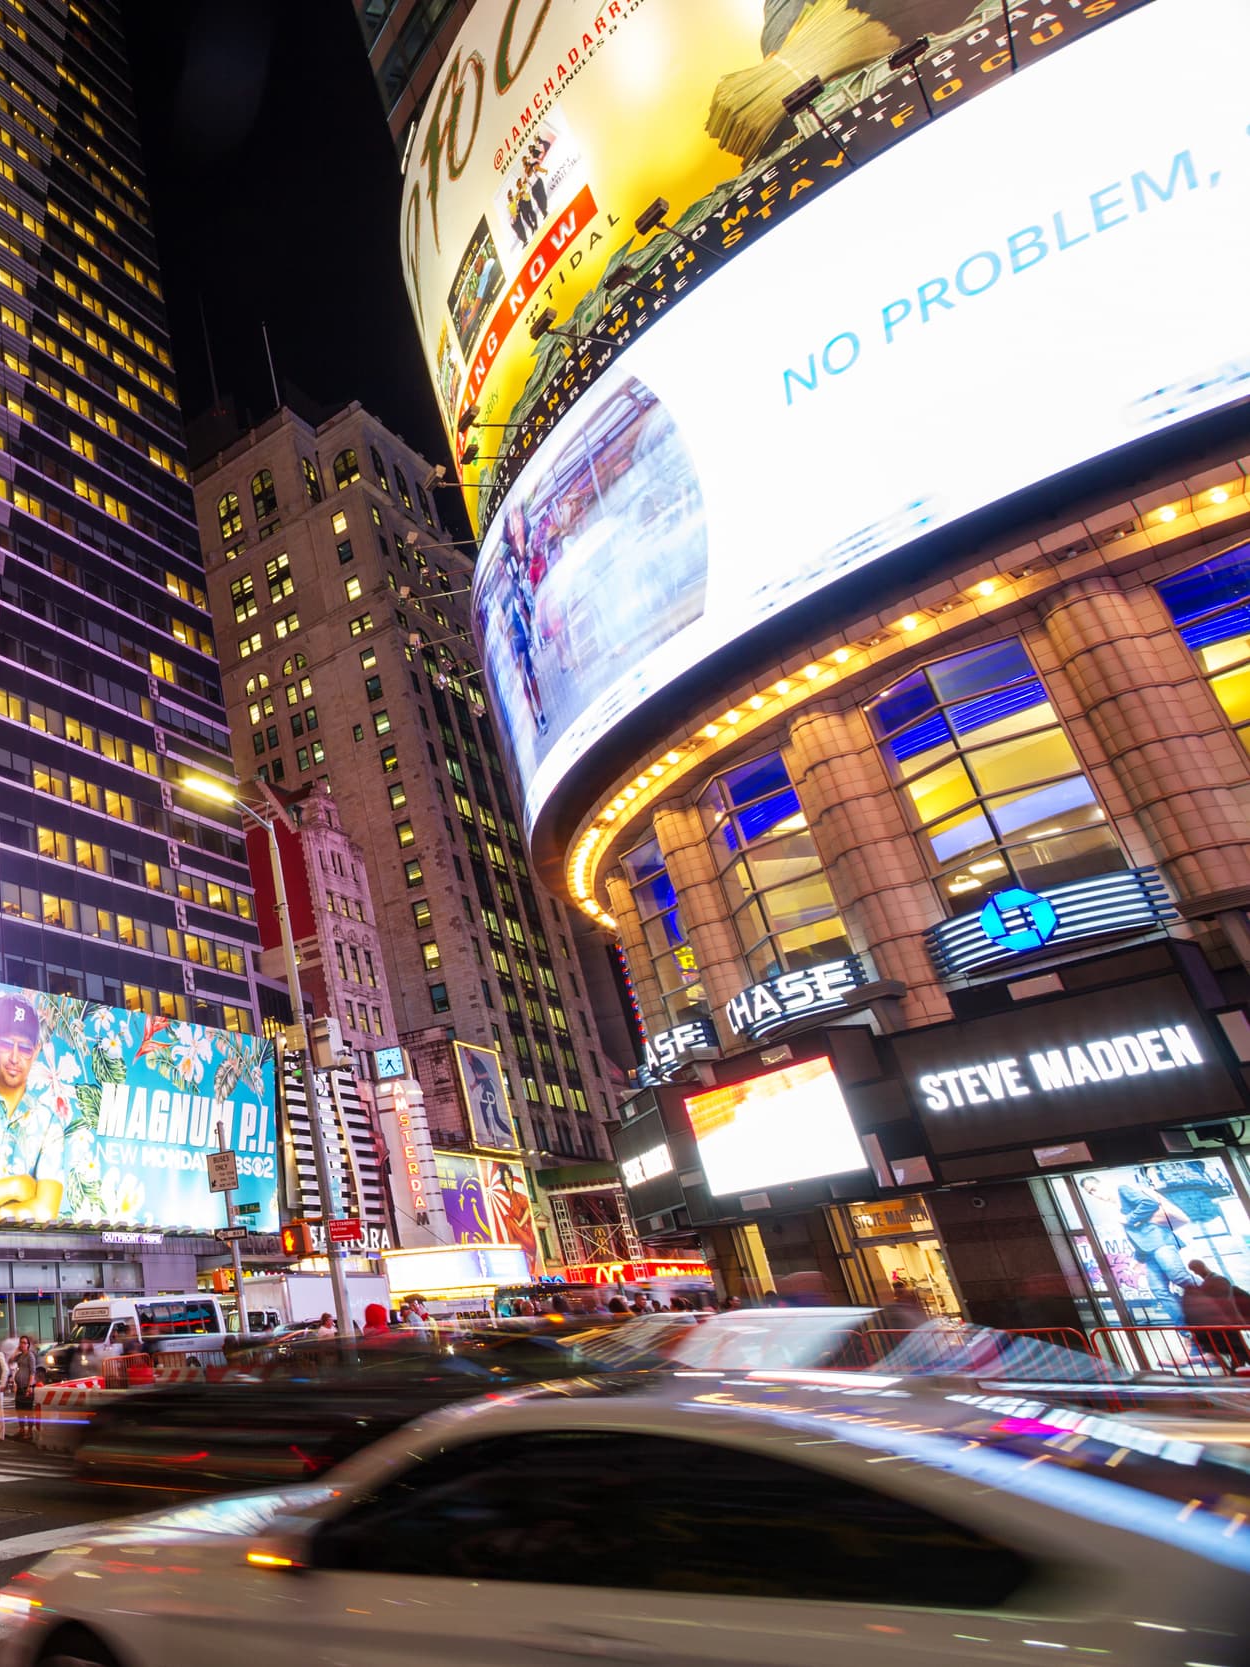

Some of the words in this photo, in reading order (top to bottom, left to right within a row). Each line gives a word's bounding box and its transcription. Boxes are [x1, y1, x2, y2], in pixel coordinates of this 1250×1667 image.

[493, 0, 630, 171] @IAMCHADARR
[500, 100, 552, 175] BILLBOARD
[554, 37, 605, 98] SINGLES
[822, 0, 1050, 139] BILLBOA
[722, 151, 844, 248] STAY
[509, 210, 576, 315] NOW
[544, 213, 620, 300] TIDAL
[608, 250, 695, 336] WITH
[783, 331, 860, 406] NO
[881, 149, 1221, 345] PROBLEM,
[726, 960, 857, 1035] CHASE
[919, 1058, 1031, 1111] STEVE
[1029, 1024, 1204, 1091] MADDEN
[96, 1141, 138, 1165] NEW
[141, 1146, 208, 1172] MONDAY
[97, 1082, 234, 1150] MAGNUM
[238, 1102, 275, 1154] P.I.
[392, 1079, 431, 1226] AMSTERDAM
